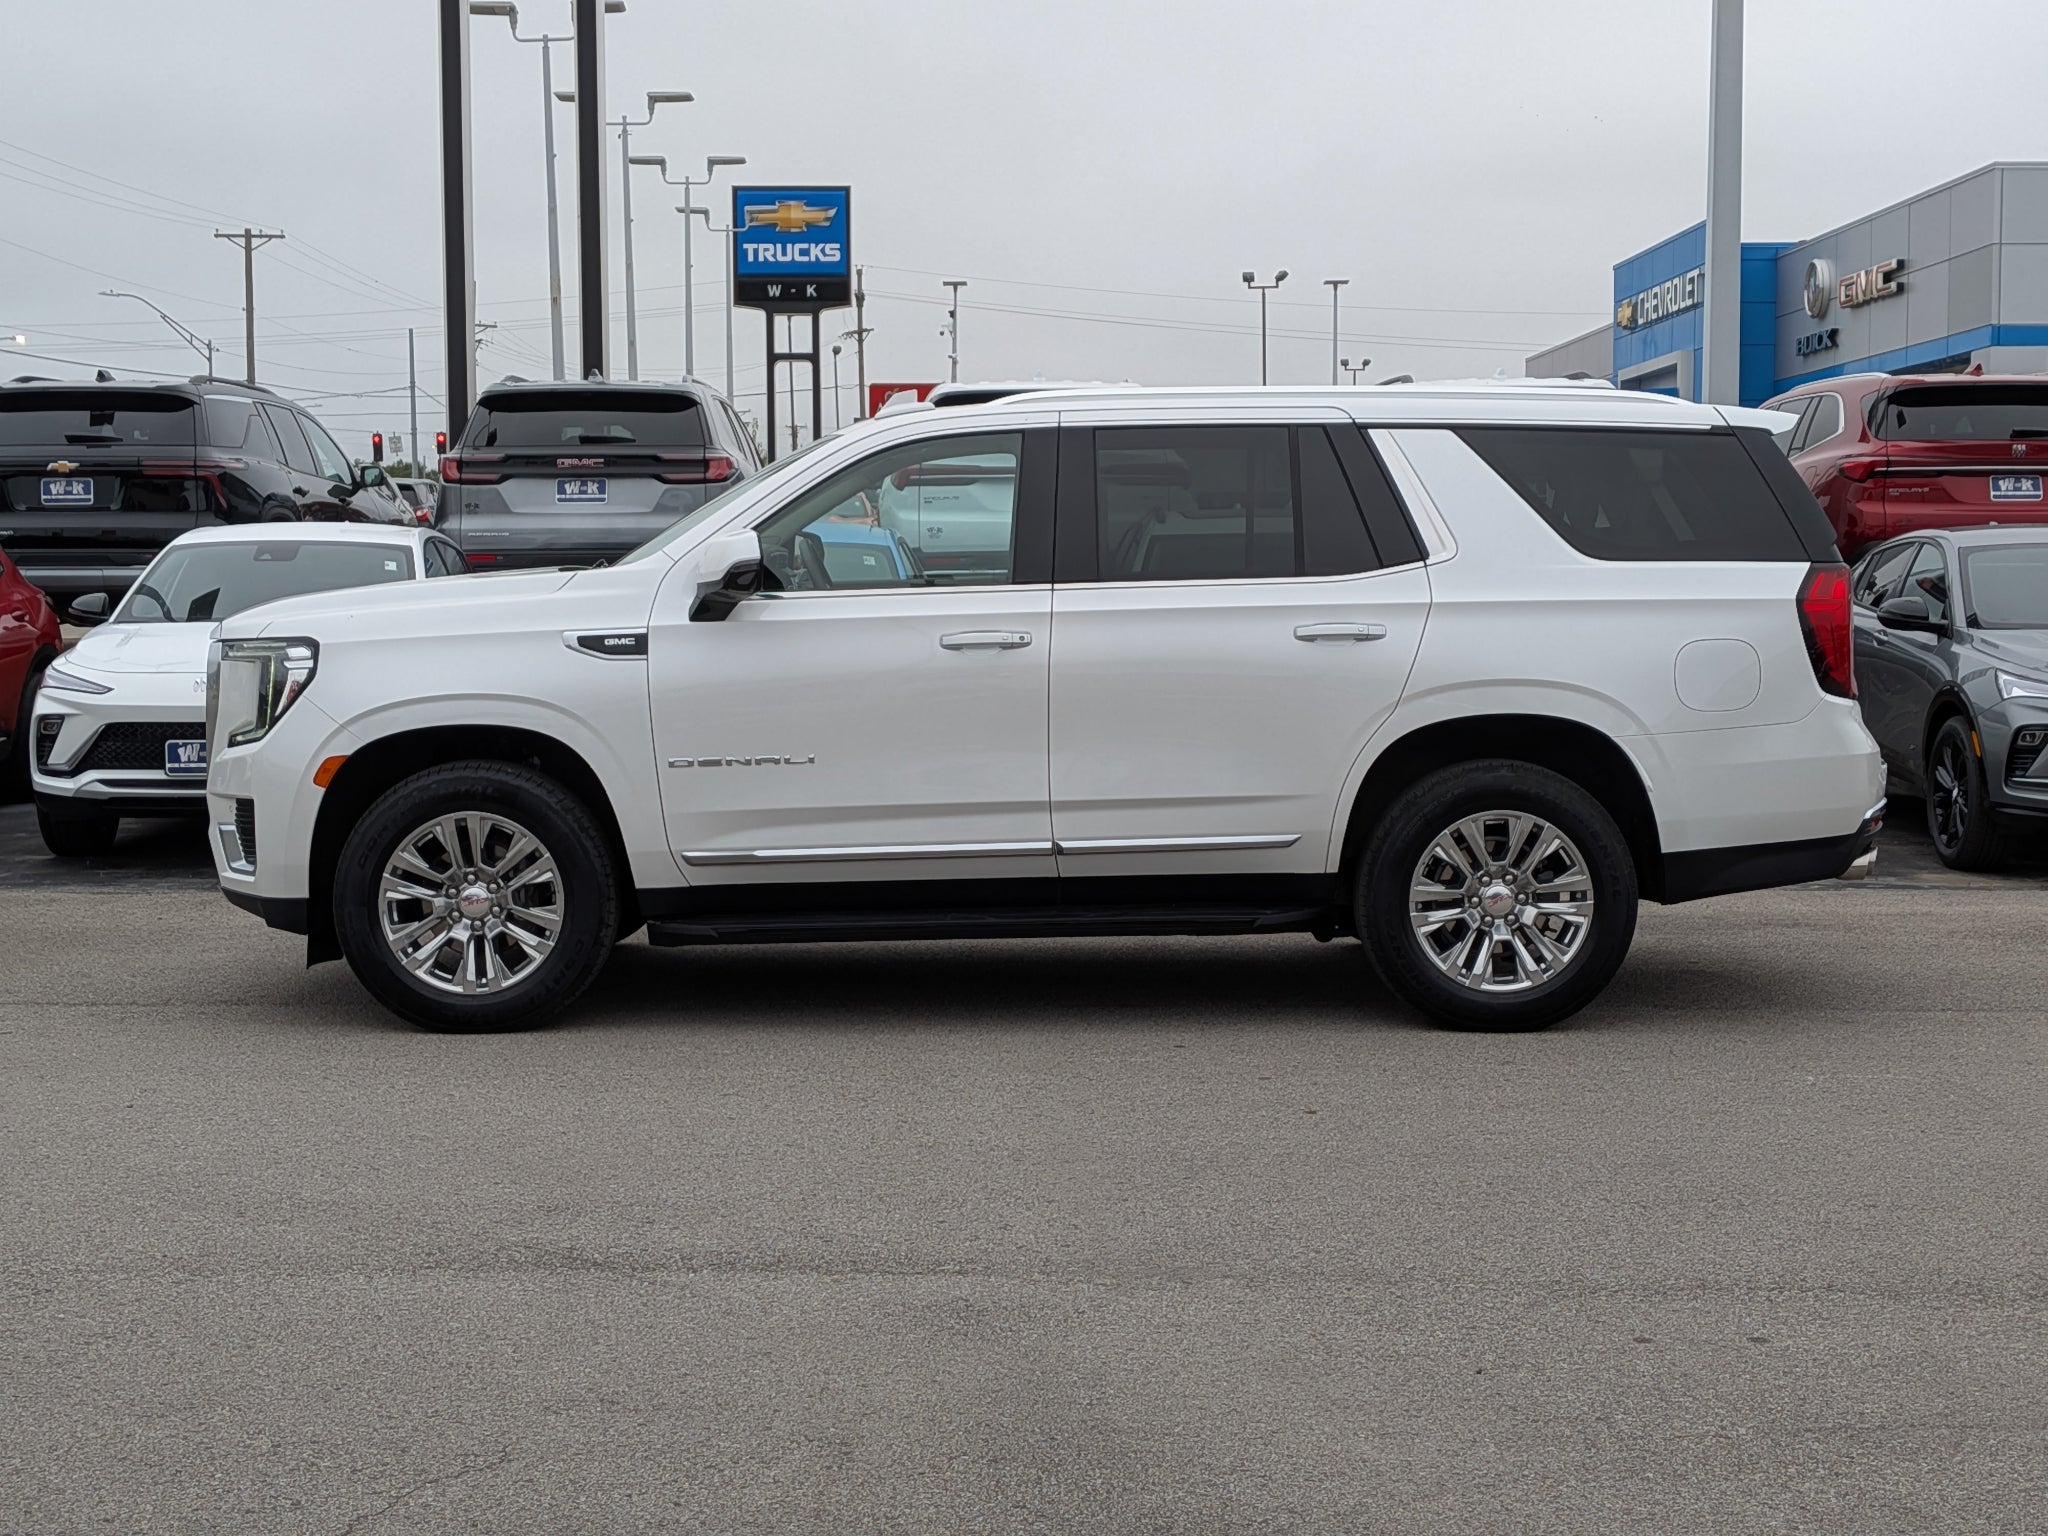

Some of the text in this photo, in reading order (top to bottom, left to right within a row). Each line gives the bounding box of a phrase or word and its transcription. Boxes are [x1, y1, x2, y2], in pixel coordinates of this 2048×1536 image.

[743, 243, 840, 262] TRUCKS
[1838, 259, 1898, 309] GMC
[1638, 267, 1701, 326] CHEVROLET
[1796, 328, 1835, 356] BUICK
[557, 458, 604, 468] GMC
[49, 480, 85, 495] W-K
[564, 480, 599, 495] W-K
[1998, 477, 2034, 491] W-K
[604, 637, 636, 646] GMC
[668, 754, 815, 769] DENALI
